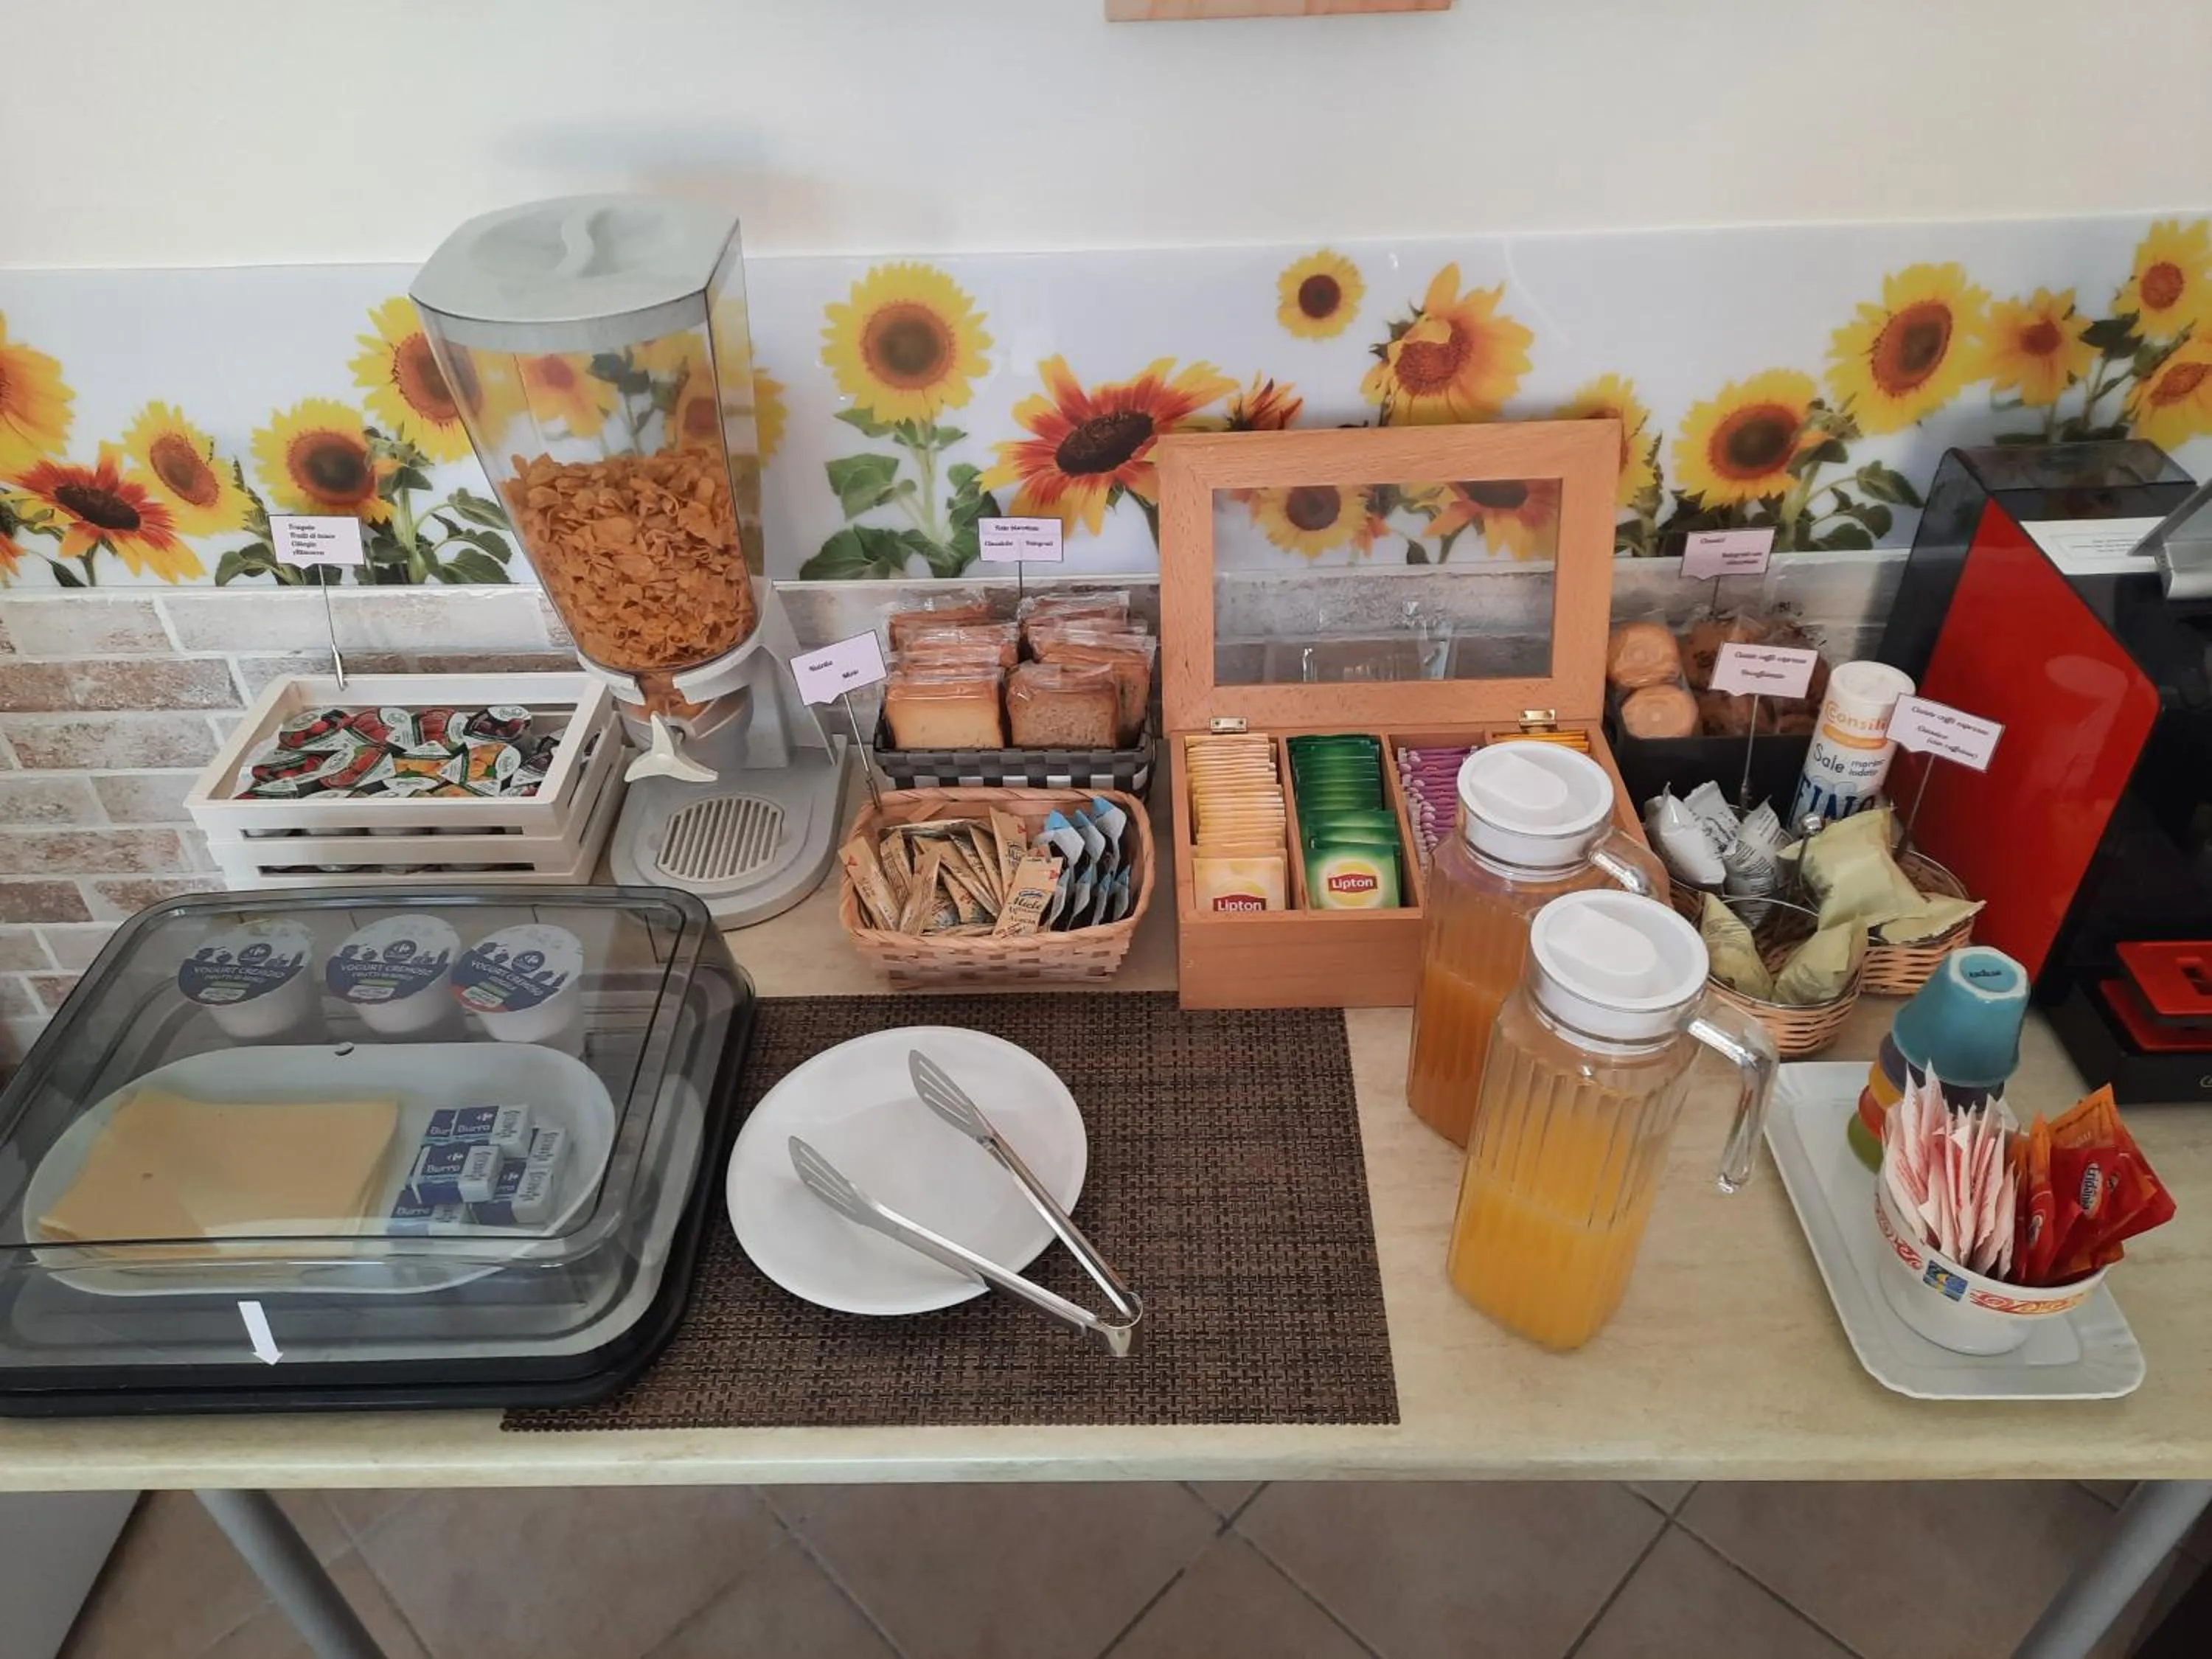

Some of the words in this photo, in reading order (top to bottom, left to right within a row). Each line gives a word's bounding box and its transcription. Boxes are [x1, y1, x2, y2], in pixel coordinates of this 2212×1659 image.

[1825, 701, 1888, 731] Consili
[1814, 743, 1845, 773] Sale
[1332, 877, 1374, 889] Lipton
[1217, 899, 1262, 912] Lipton
[431, 1126, 451, 1135] Bur
[457, 1124, 490, 1133] Burro
[428, 1164, 461, 1173] Burro
[396, 1207, 430, 1215] Burro
